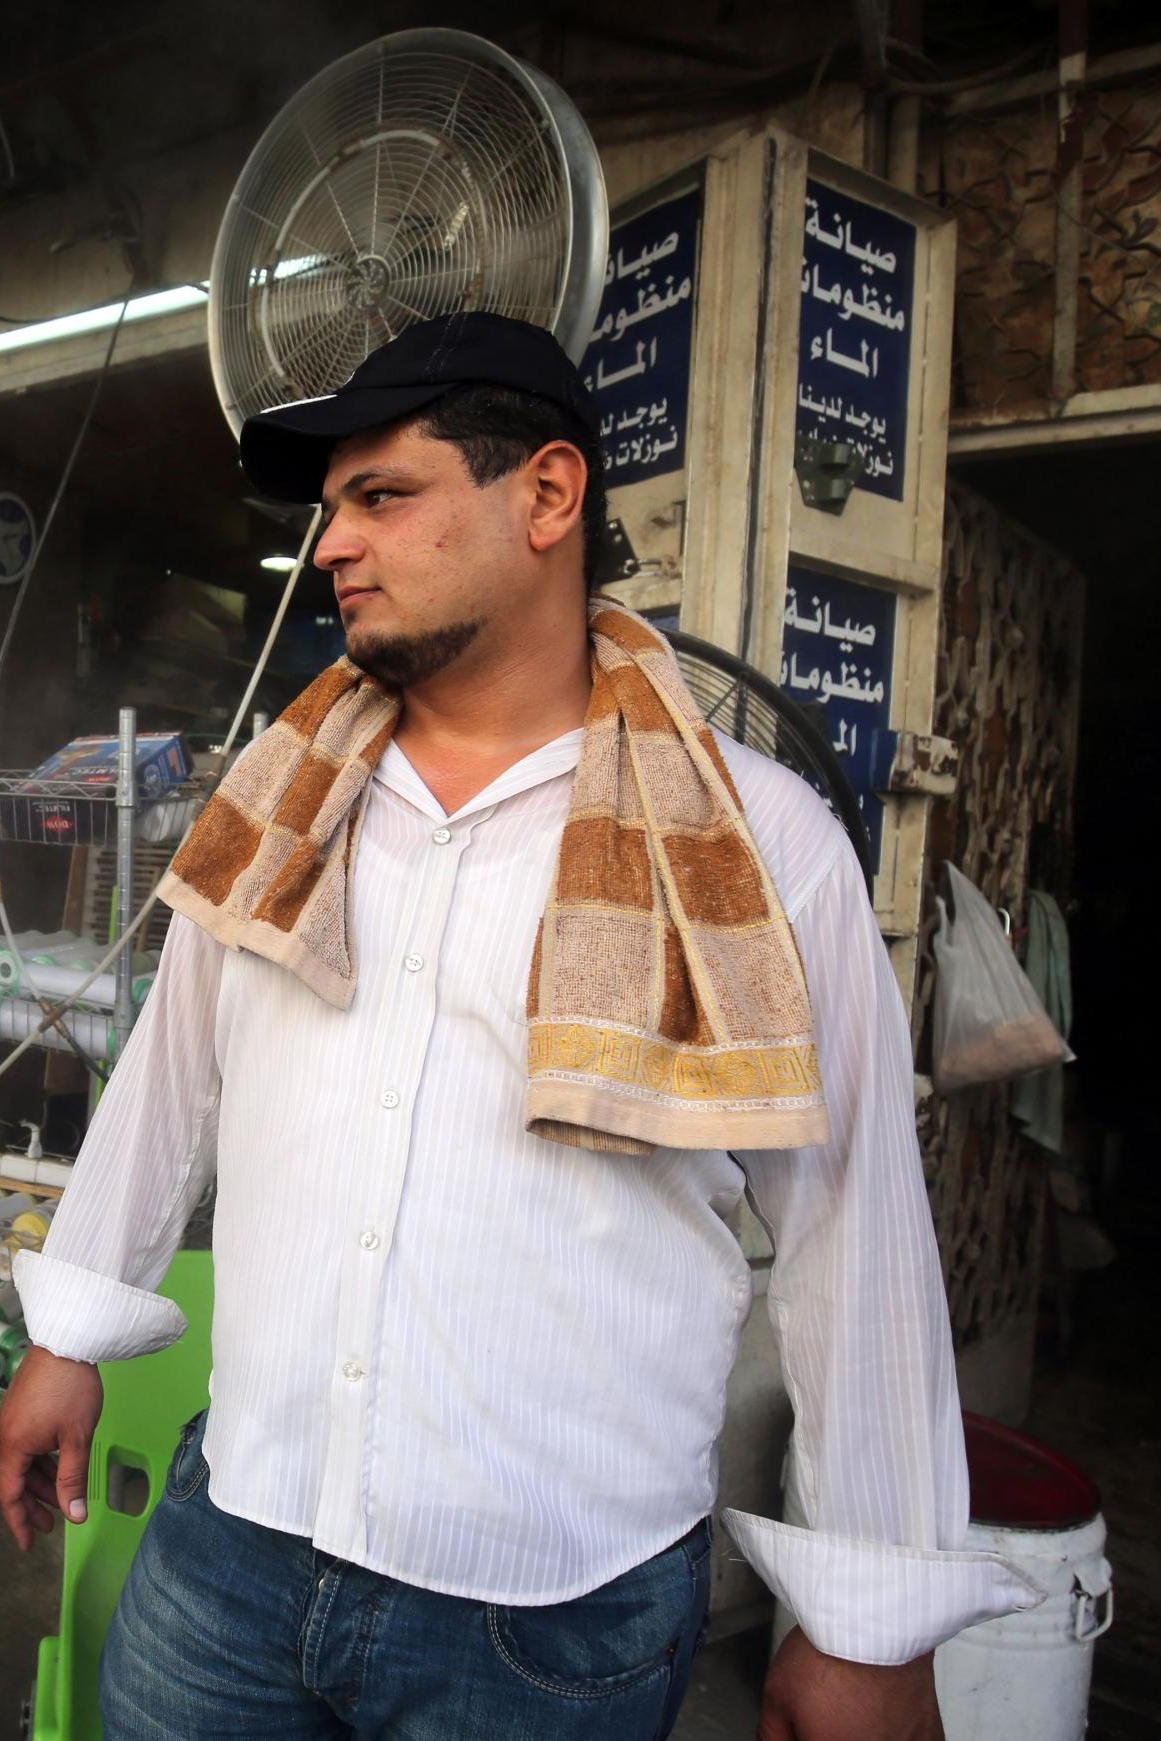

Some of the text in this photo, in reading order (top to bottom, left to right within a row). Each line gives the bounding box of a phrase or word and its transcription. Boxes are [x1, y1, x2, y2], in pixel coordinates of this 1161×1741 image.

[605, 231, 679, 285] صيان
[805, 197, 897, 275] صيانة
[589, 276, 691, 341] منظوم
[811, 327, 878, 378] الماء
[617, 397, 668, 431] يوجد
[845, 403, 886, 444] يوجد
